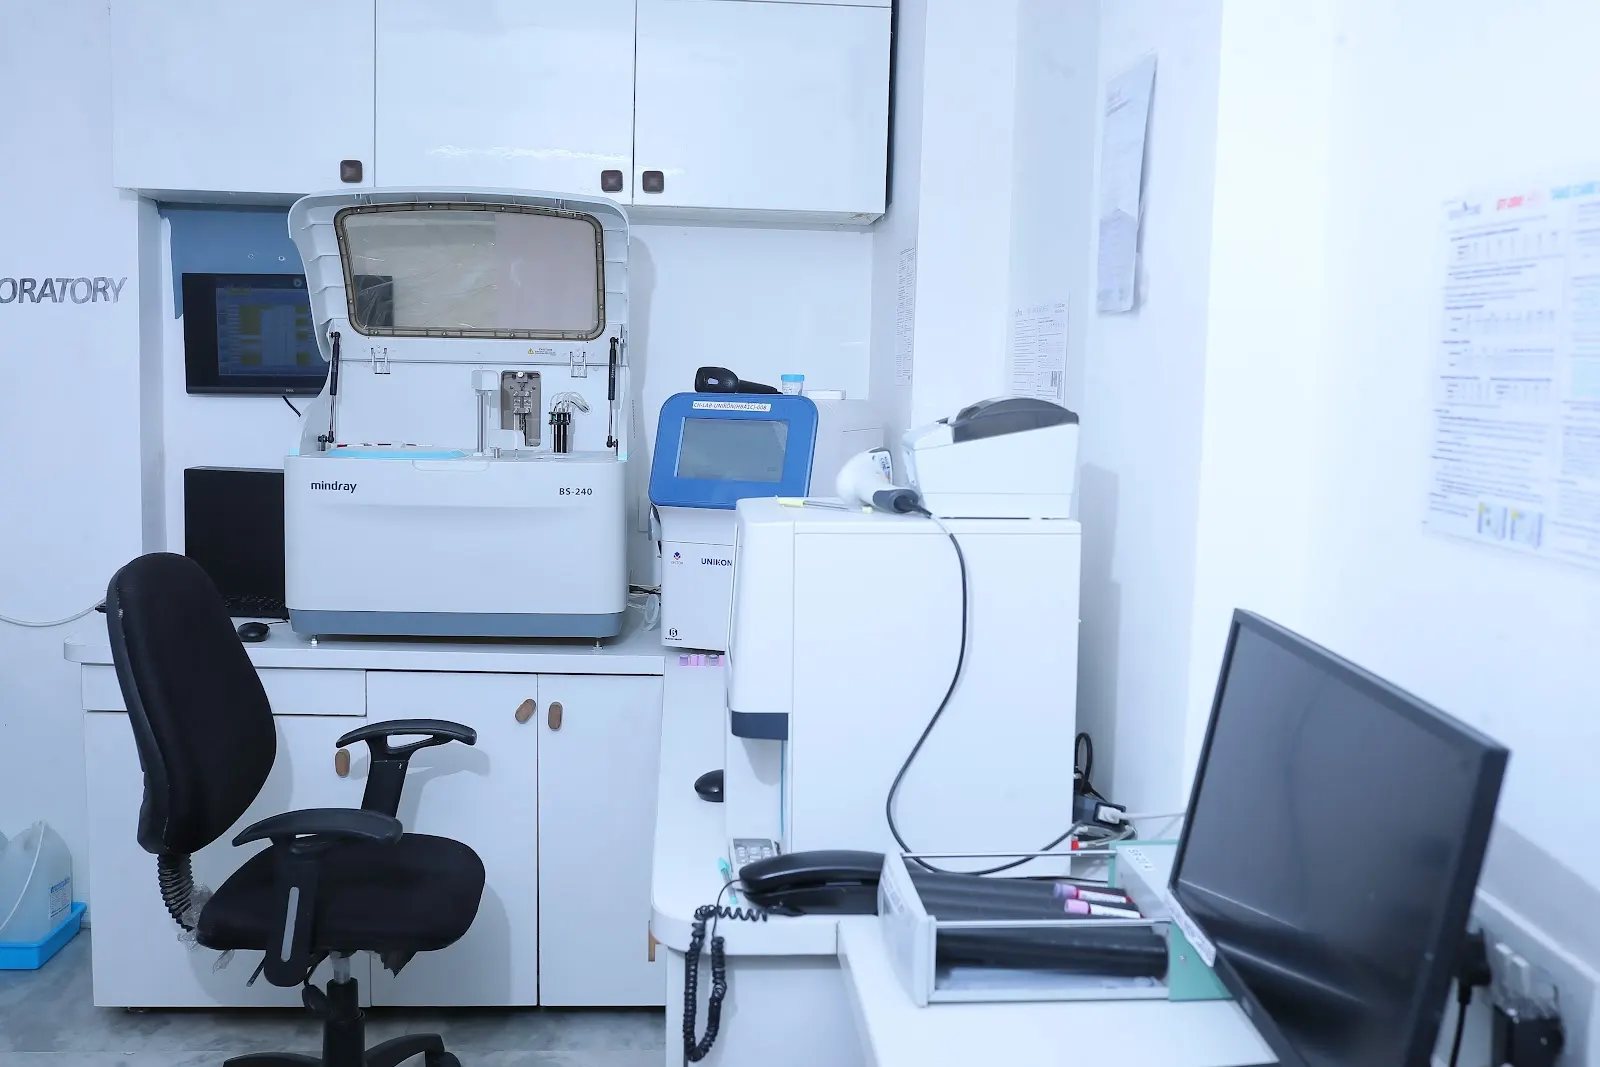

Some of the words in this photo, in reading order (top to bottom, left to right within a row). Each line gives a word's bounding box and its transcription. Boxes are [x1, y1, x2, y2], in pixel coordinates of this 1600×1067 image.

[0, 277, 127, 304] ORATORY
[311, 480, 357, 494] mindray
[559, 487, 593, 496] BS-240
